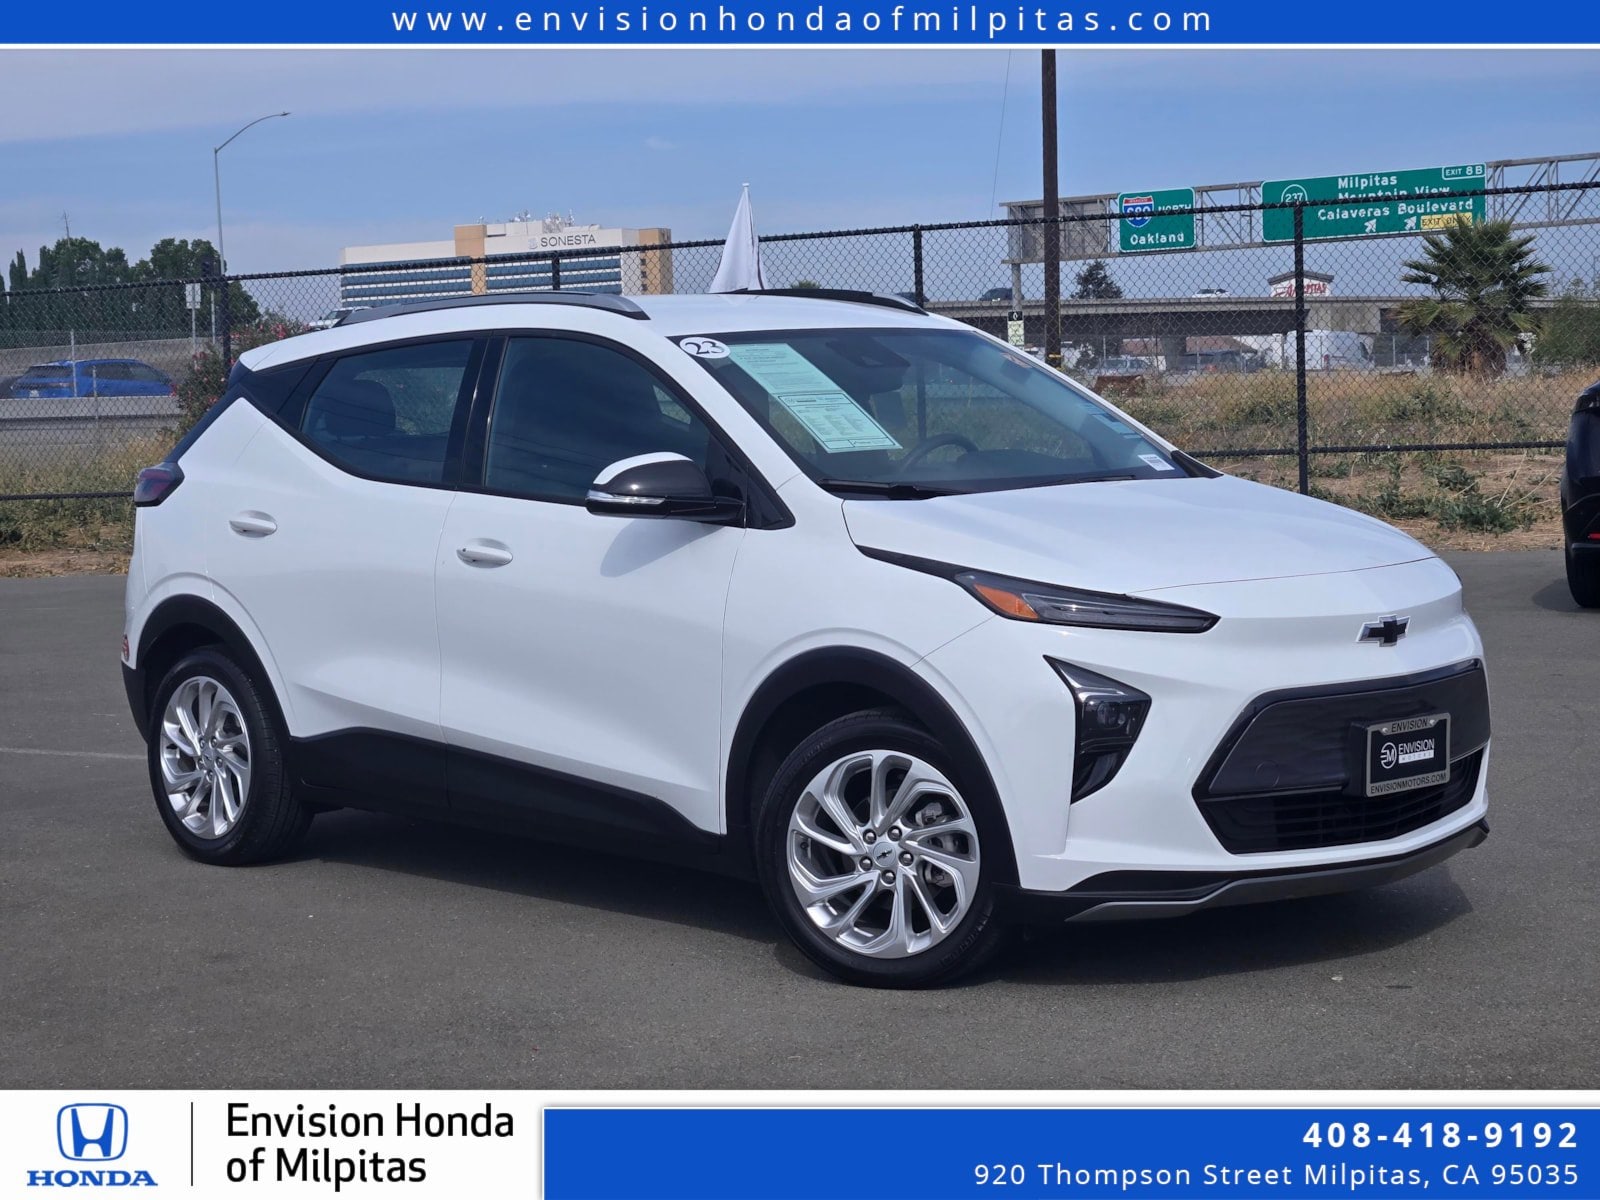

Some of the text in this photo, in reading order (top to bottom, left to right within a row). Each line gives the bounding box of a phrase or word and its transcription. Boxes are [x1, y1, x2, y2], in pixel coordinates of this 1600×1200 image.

[1445, 168, 1462, 177] EXIT
[1337, 174, 1398, 190] Milpitas
[1285, 192, 1304, 203] 237
[1317, 198, 1473, 221] Calaveras Boulevard
[1422, 217, 1441, 227] EXIT
[540, 233, 597, 248] SONESTA
[1130, 231, 1185, 246] Oakland
[685, 340, 725, 354] 23
[1391, 717, 1428, 733] ENVISION
[1398, 738, 1435, 755] ENVISION
[1370, 772, 1447, 794] ENVISIONMOTORS.COM
